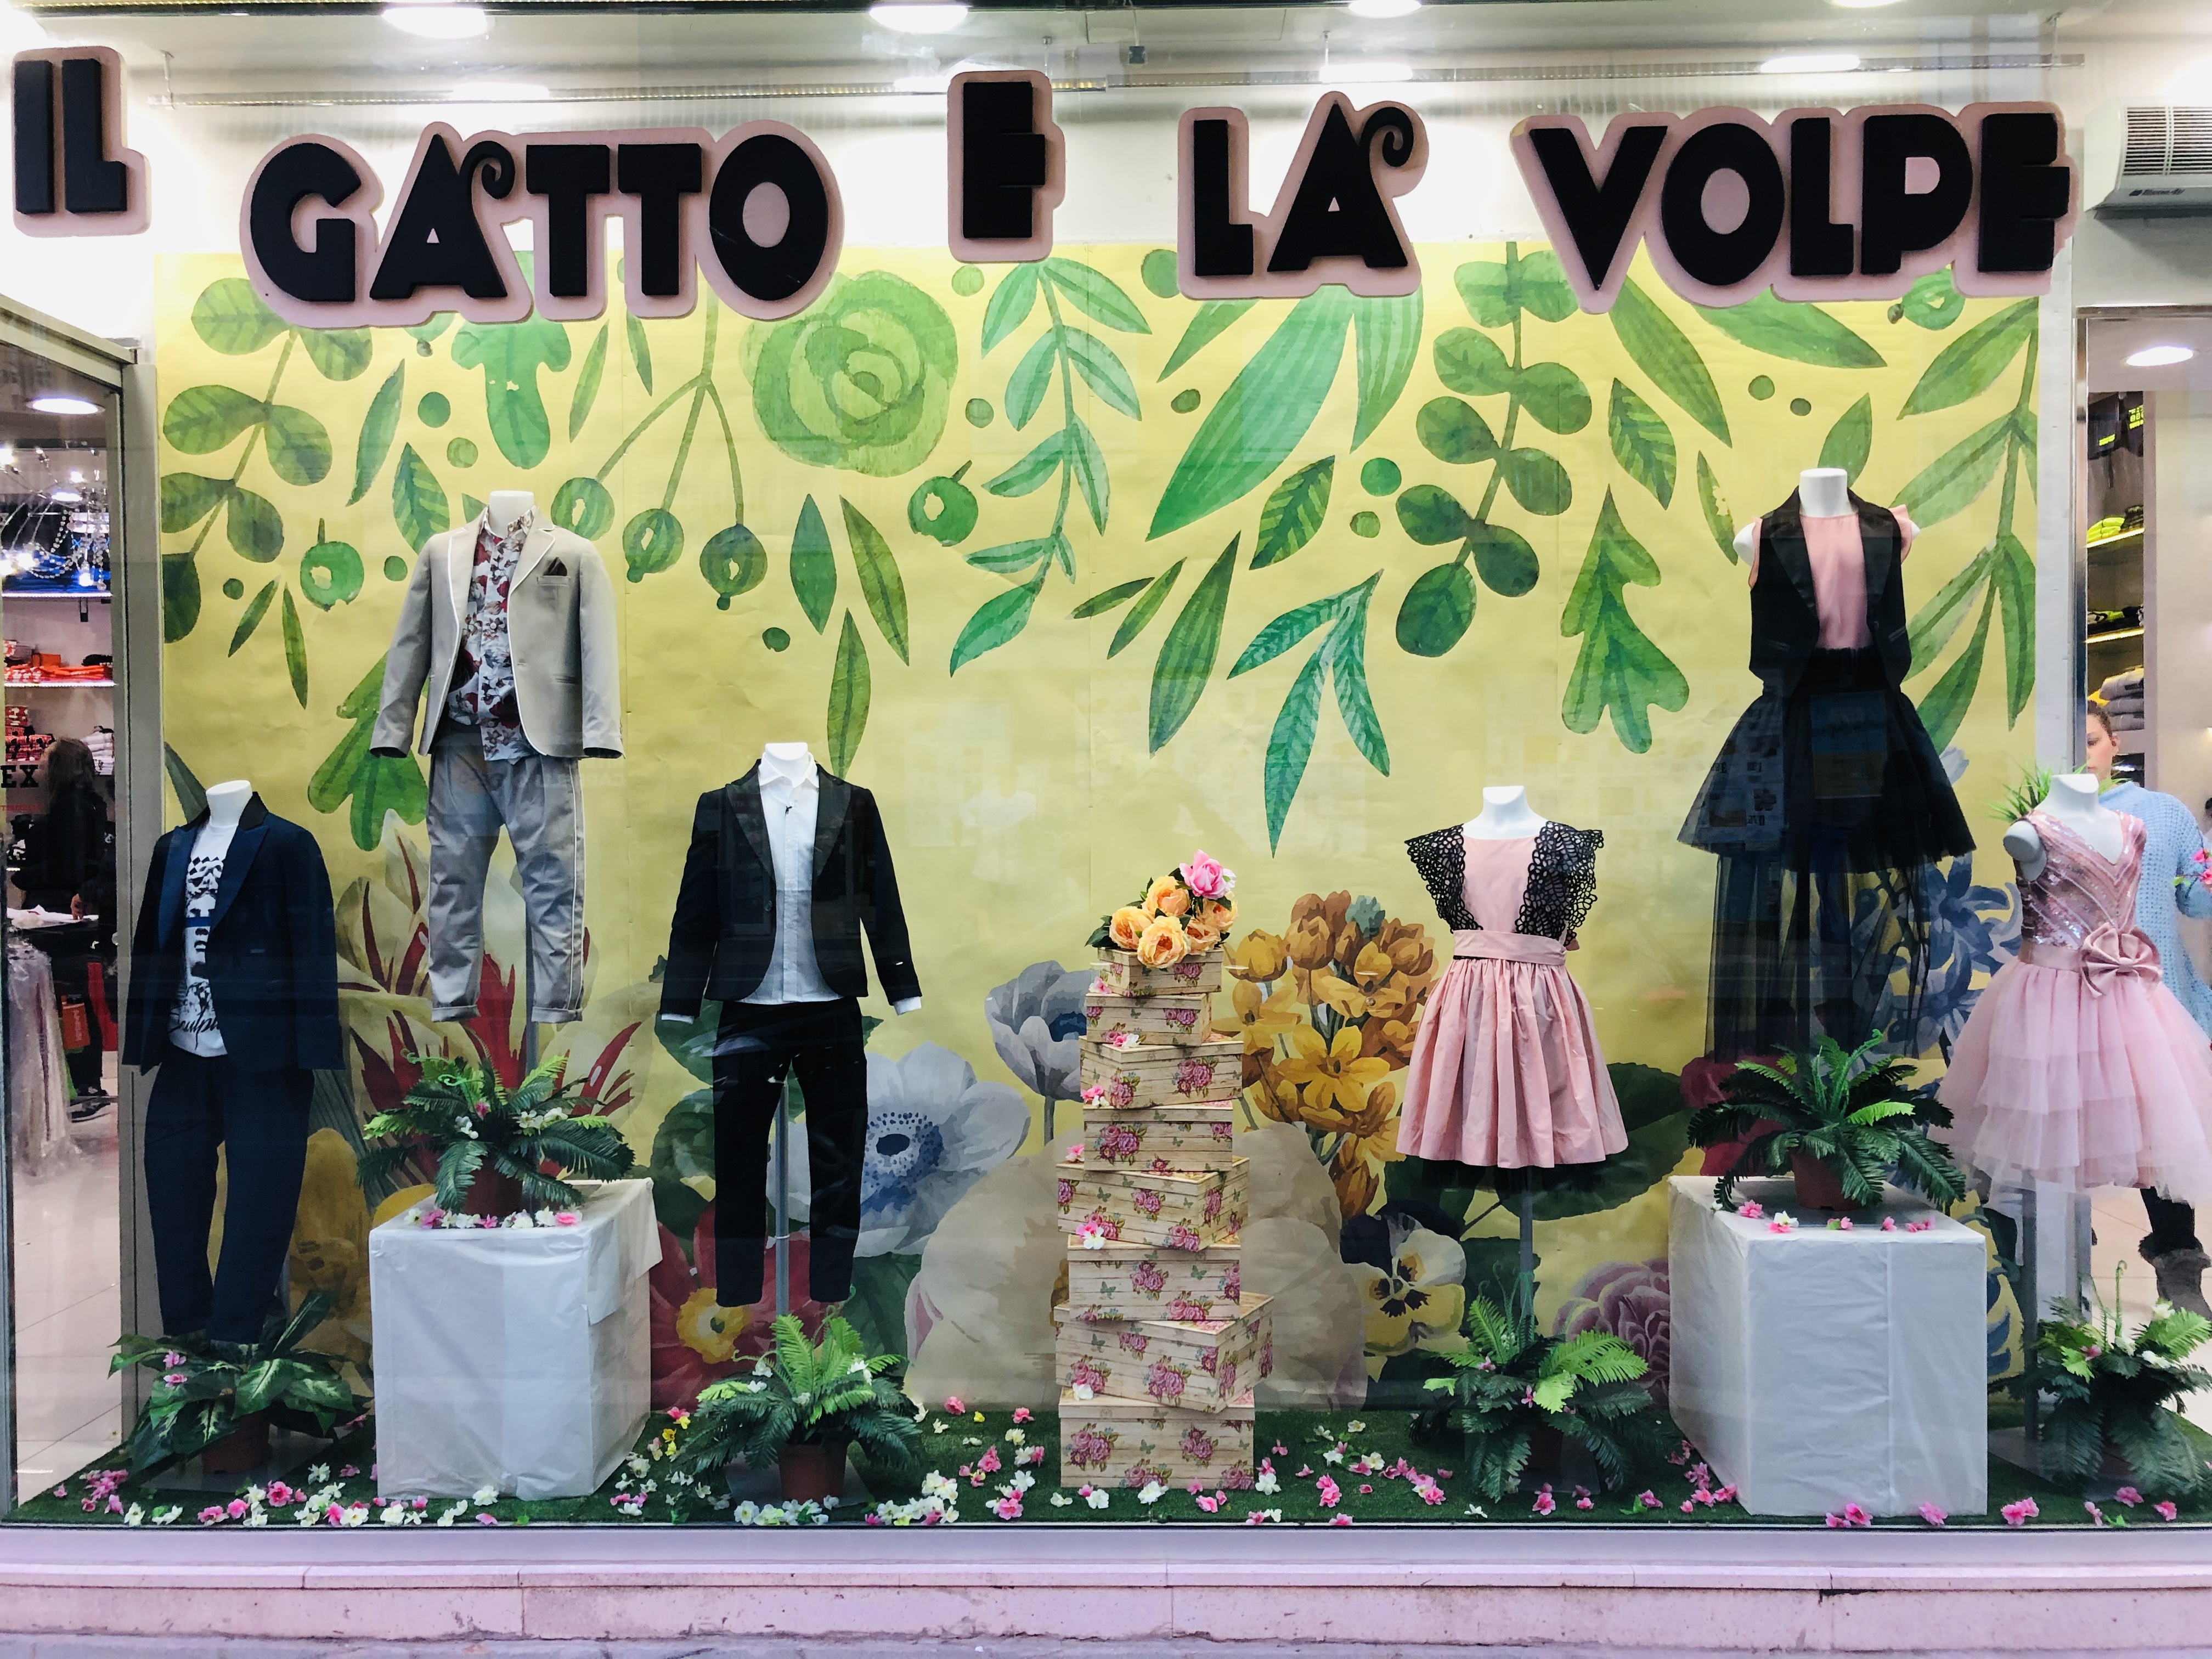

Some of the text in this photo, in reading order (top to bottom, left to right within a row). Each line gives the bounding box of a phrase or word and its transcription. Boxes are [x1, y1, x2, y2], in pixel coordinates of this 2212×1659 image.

[14, 58, 2070, 303] IL GATTO E LA VOLPE
